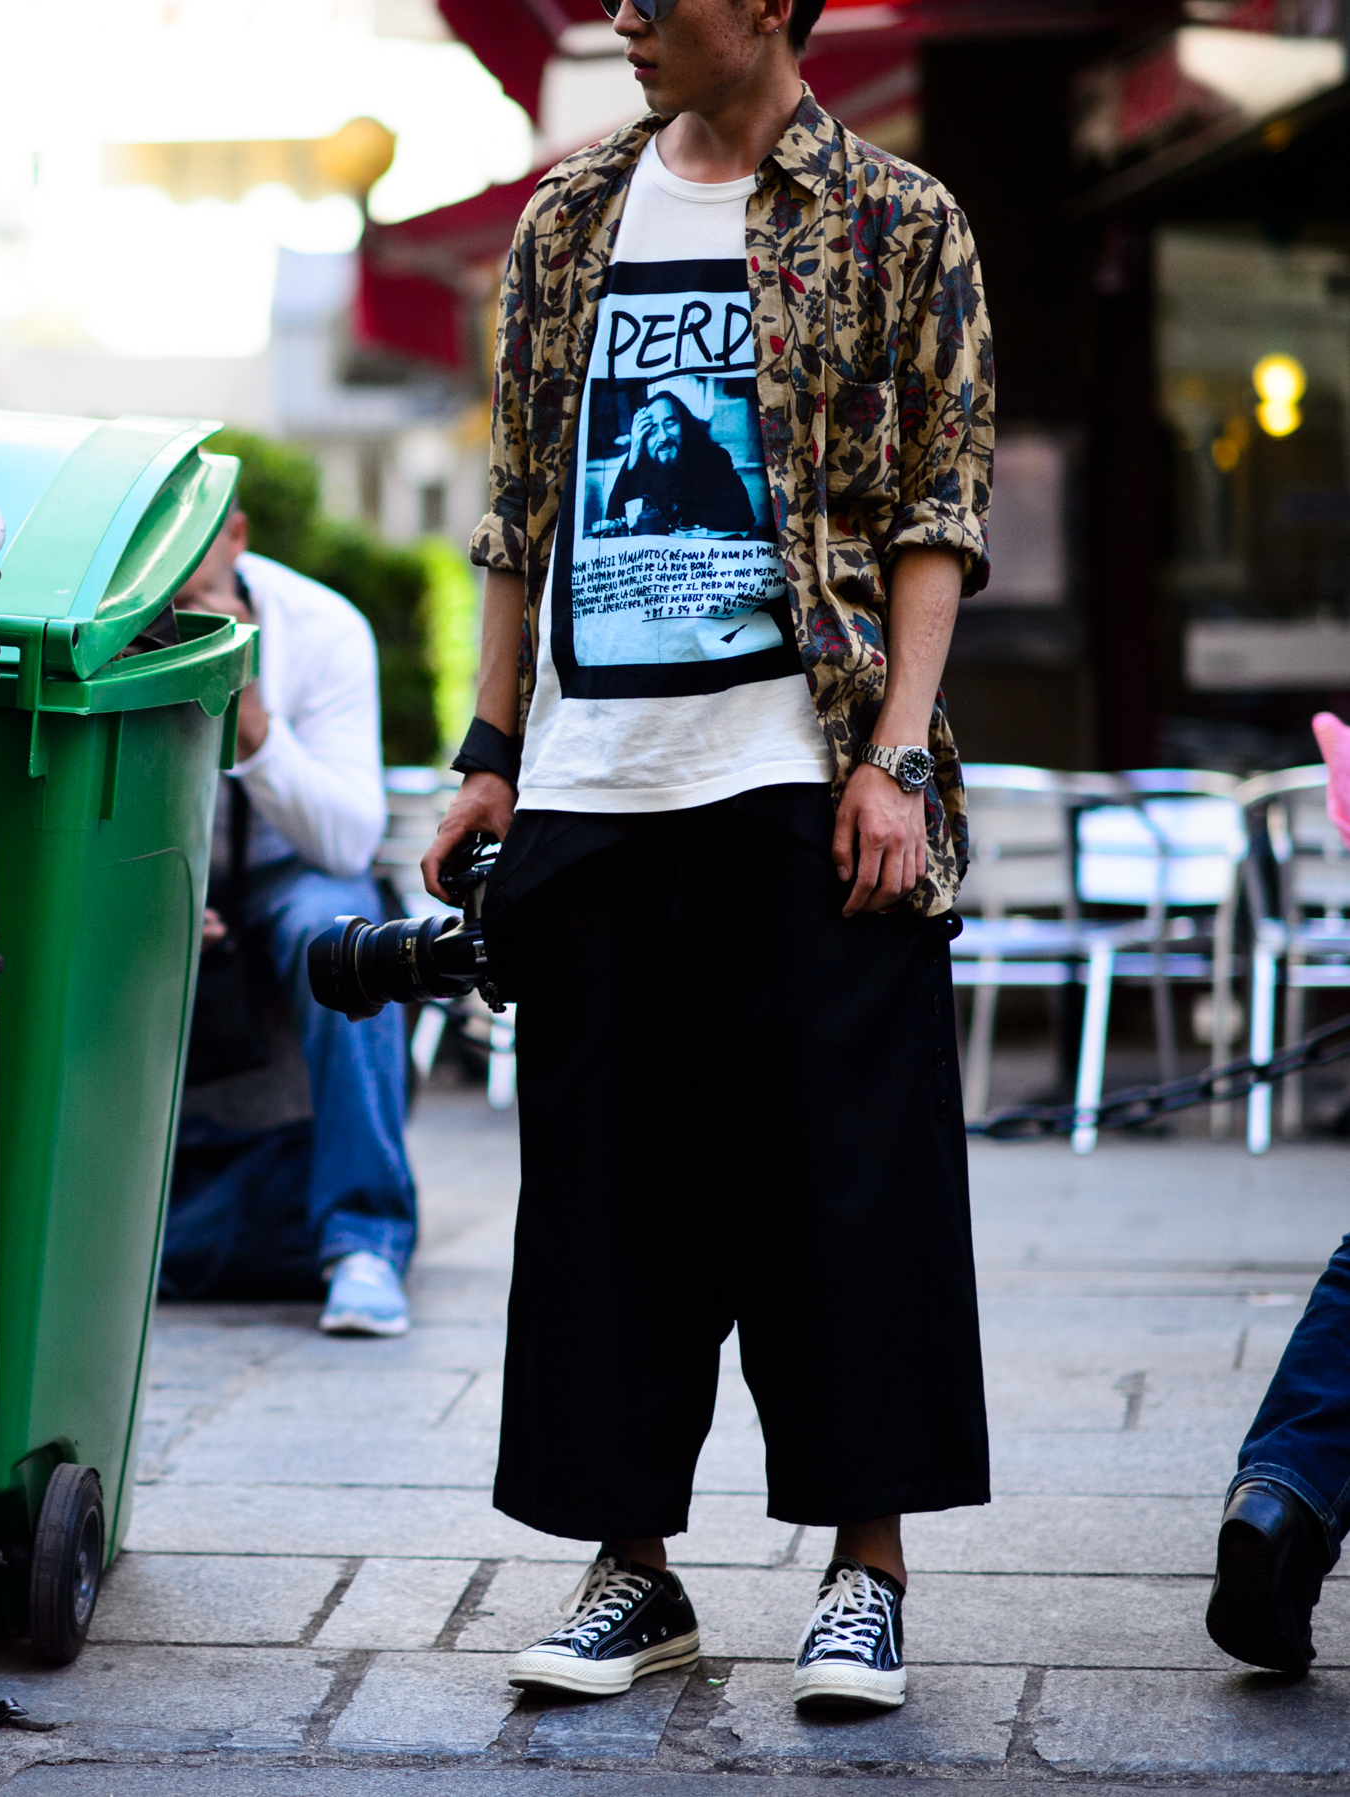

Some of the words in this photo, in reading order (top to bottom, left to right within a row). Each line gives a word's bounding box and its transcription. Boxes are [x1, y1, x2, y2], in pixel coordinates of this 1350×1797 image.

[591, 555, 616, 571] YOHJI
[618, 548, 661, 565] YAMAMOTO
[708, 547, 720, 560] AU
[721, 550, 740, 560] NOM
[742, 548, 754, 560] DE
[580, 574, 587, 585] A
[587, 570, 616, 583] DISPARU
[644, 562, 655, 572] DE
[656, 561, 669, 572] LA
[670, 562, 688, 572] RUE
[587, 581, 618, 594] CHAPEAU
[639, 573, 653, 585] LES
[753, 566, 778, 578] VESTE
[603, 592, 620, 603] AVEC
[620, 588, 629, 600] LA
[685, 581, 699, 591] IL
[700, 580, 723, 591] PERD
[724, 580, 736, 590] UN
[737, 582, 756, 592] PEU
[644, 594, 669, 607] MERCI
[670, 595, 681, 604] DE
[681, 593, 704, 603] NOUS
